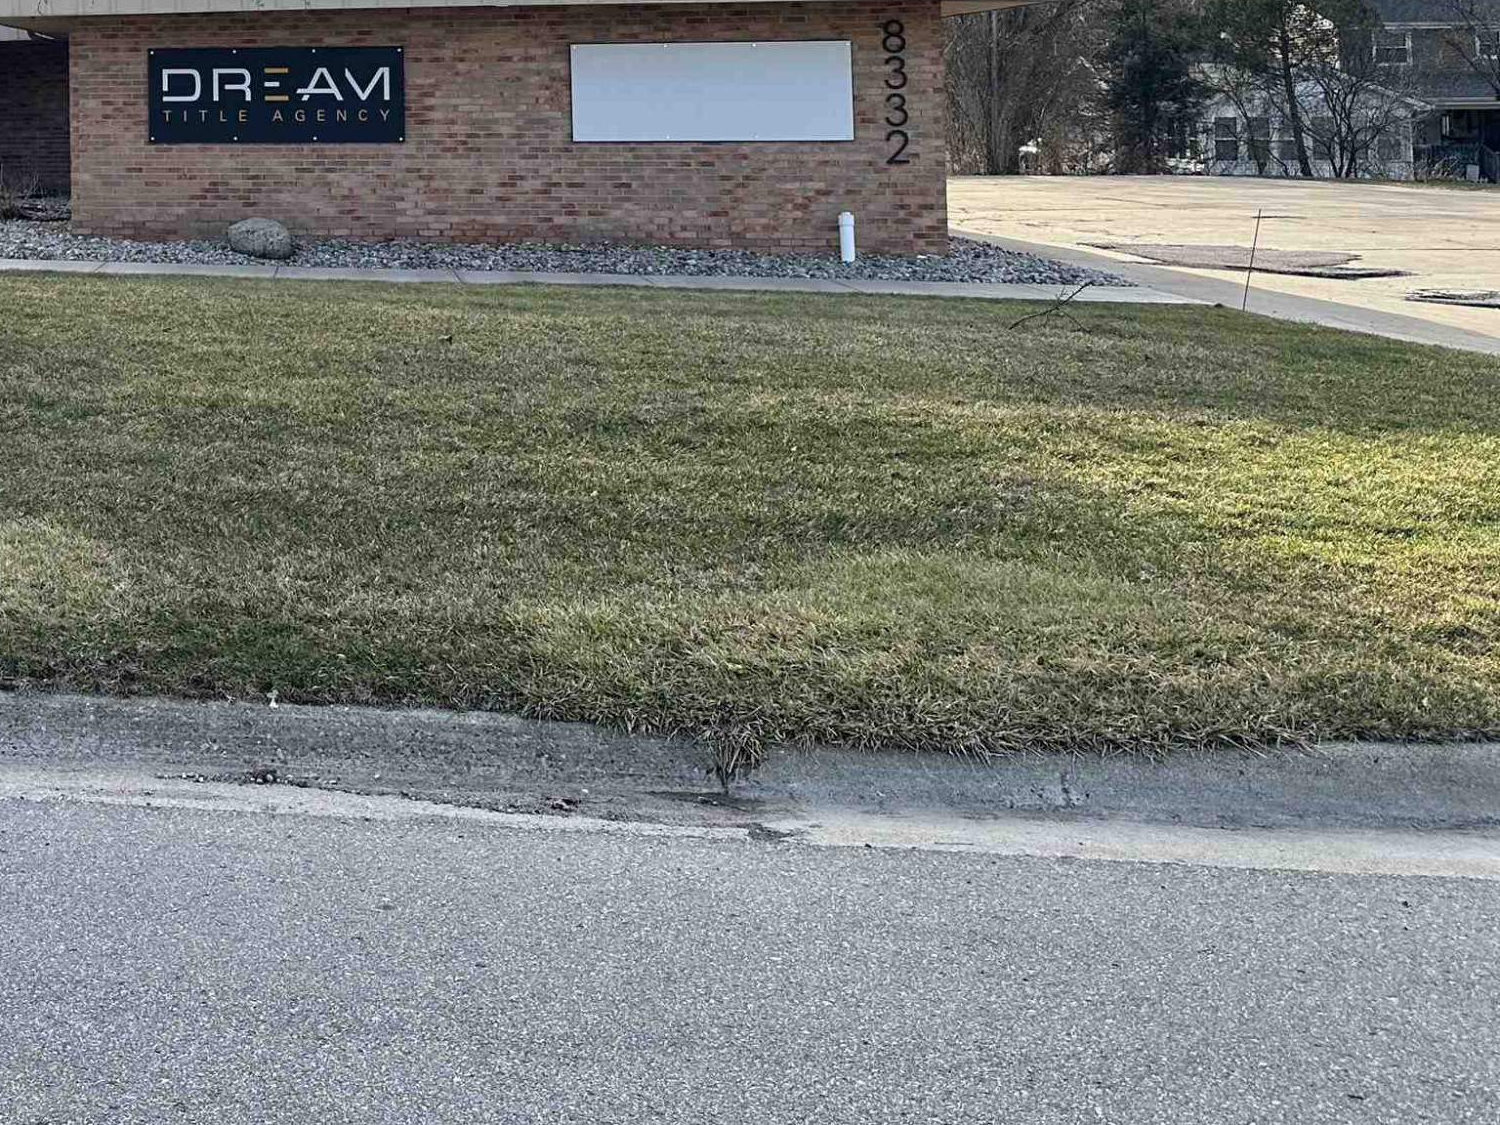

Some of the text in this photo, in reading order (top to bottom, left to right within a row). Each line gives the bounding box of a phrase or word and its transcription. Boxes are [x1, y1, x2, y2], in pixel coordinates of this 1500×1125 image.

[162, 66, 391, 103] DREAM
[882, 19, 911, 165] 8332
[162, 108, 391, 123] TITLE AGENCY
